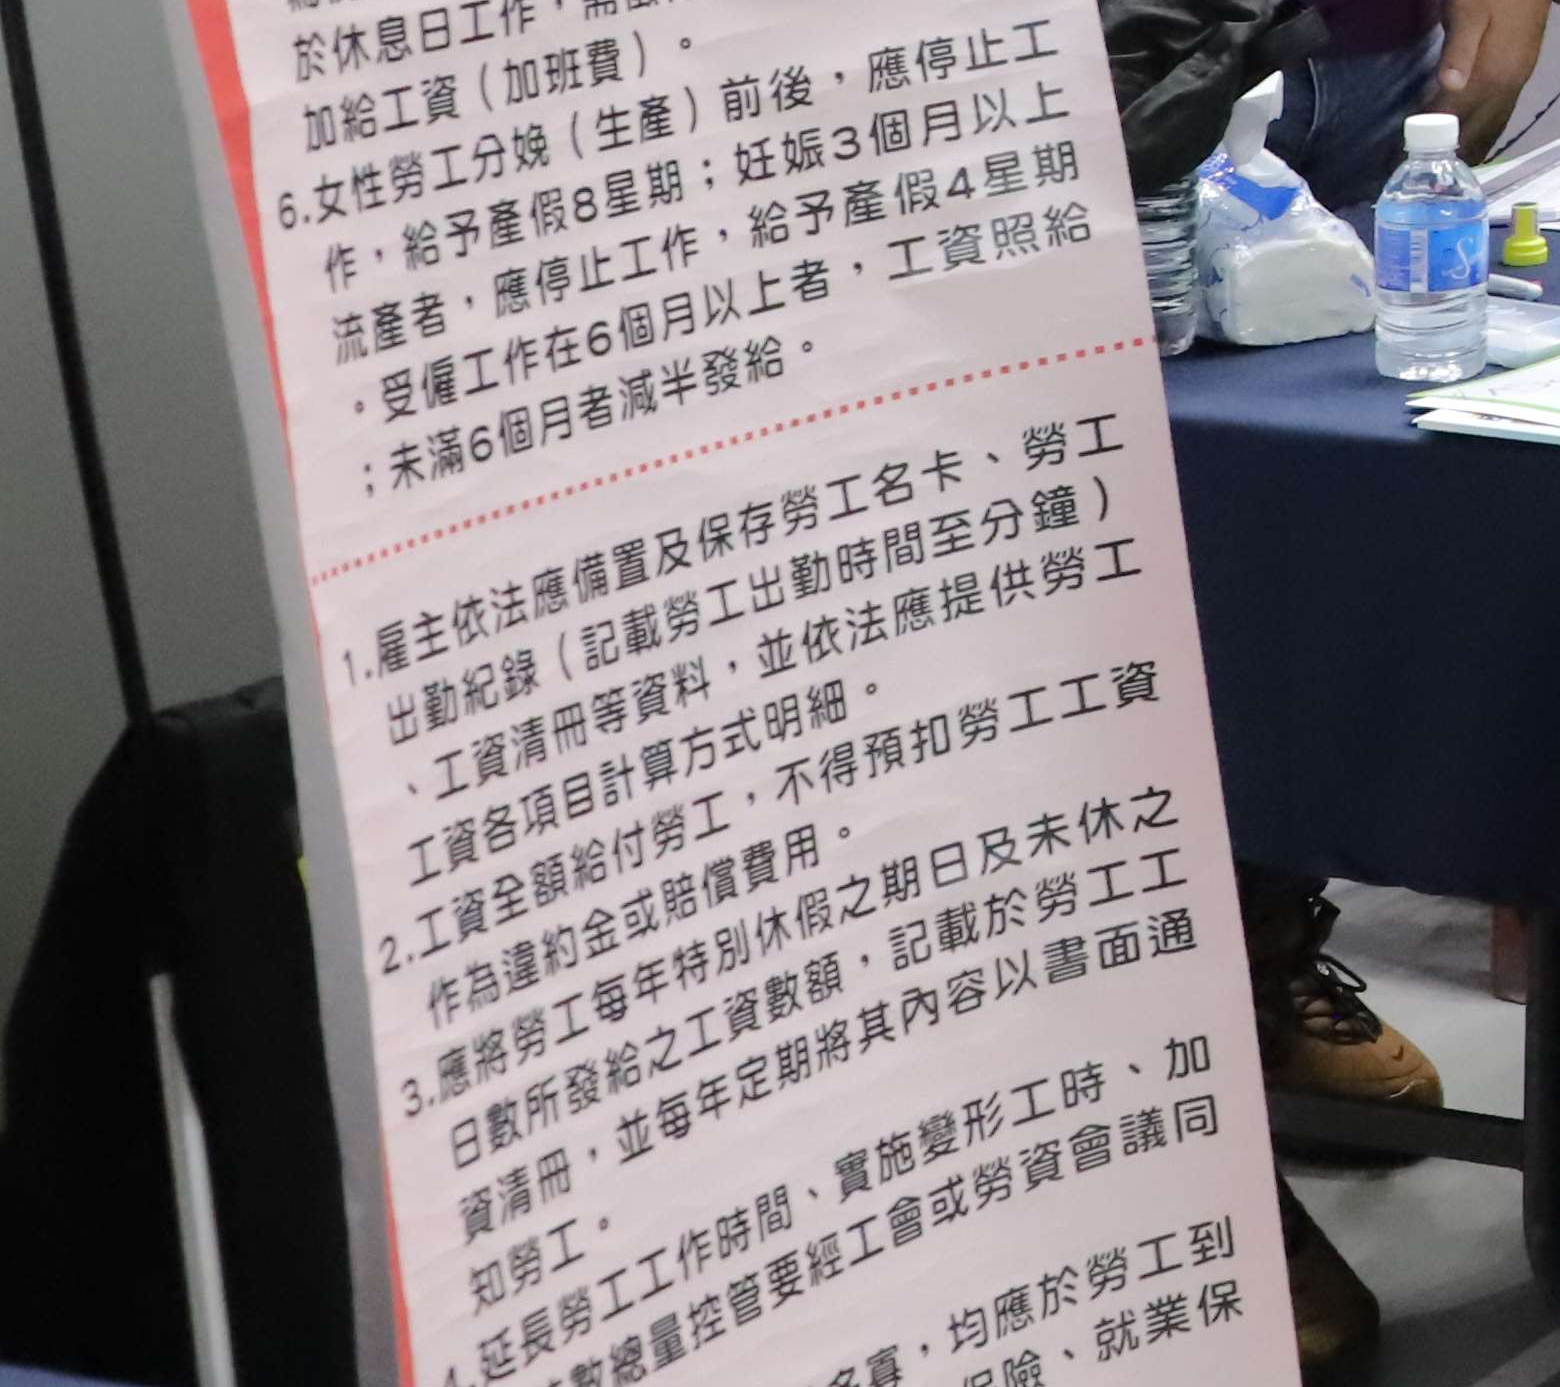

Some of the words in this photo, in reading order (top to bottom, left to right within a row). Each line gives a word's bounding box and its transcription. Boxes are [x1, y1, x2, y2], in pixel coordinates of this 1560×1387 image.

[333, 139, 1081, 367] 流產者，應停止工作，給予產假4星期
[406, 677, 880, 889] 工資各項目計算方式明細。
[426, 817, 852, 1035] 作為違約金或賠償費用。
[450, 845, 1189, 1172] 日數所發給之工資數額，記載於勞工工
[459, 905, 1198, 1249] 資清冊，並每年定期將其內容以書面通
[469, 1215, 610, 1318] 知勞工。
[545, 1095, 1221, 1387] 數總量控管要經工會或勞資會議同
